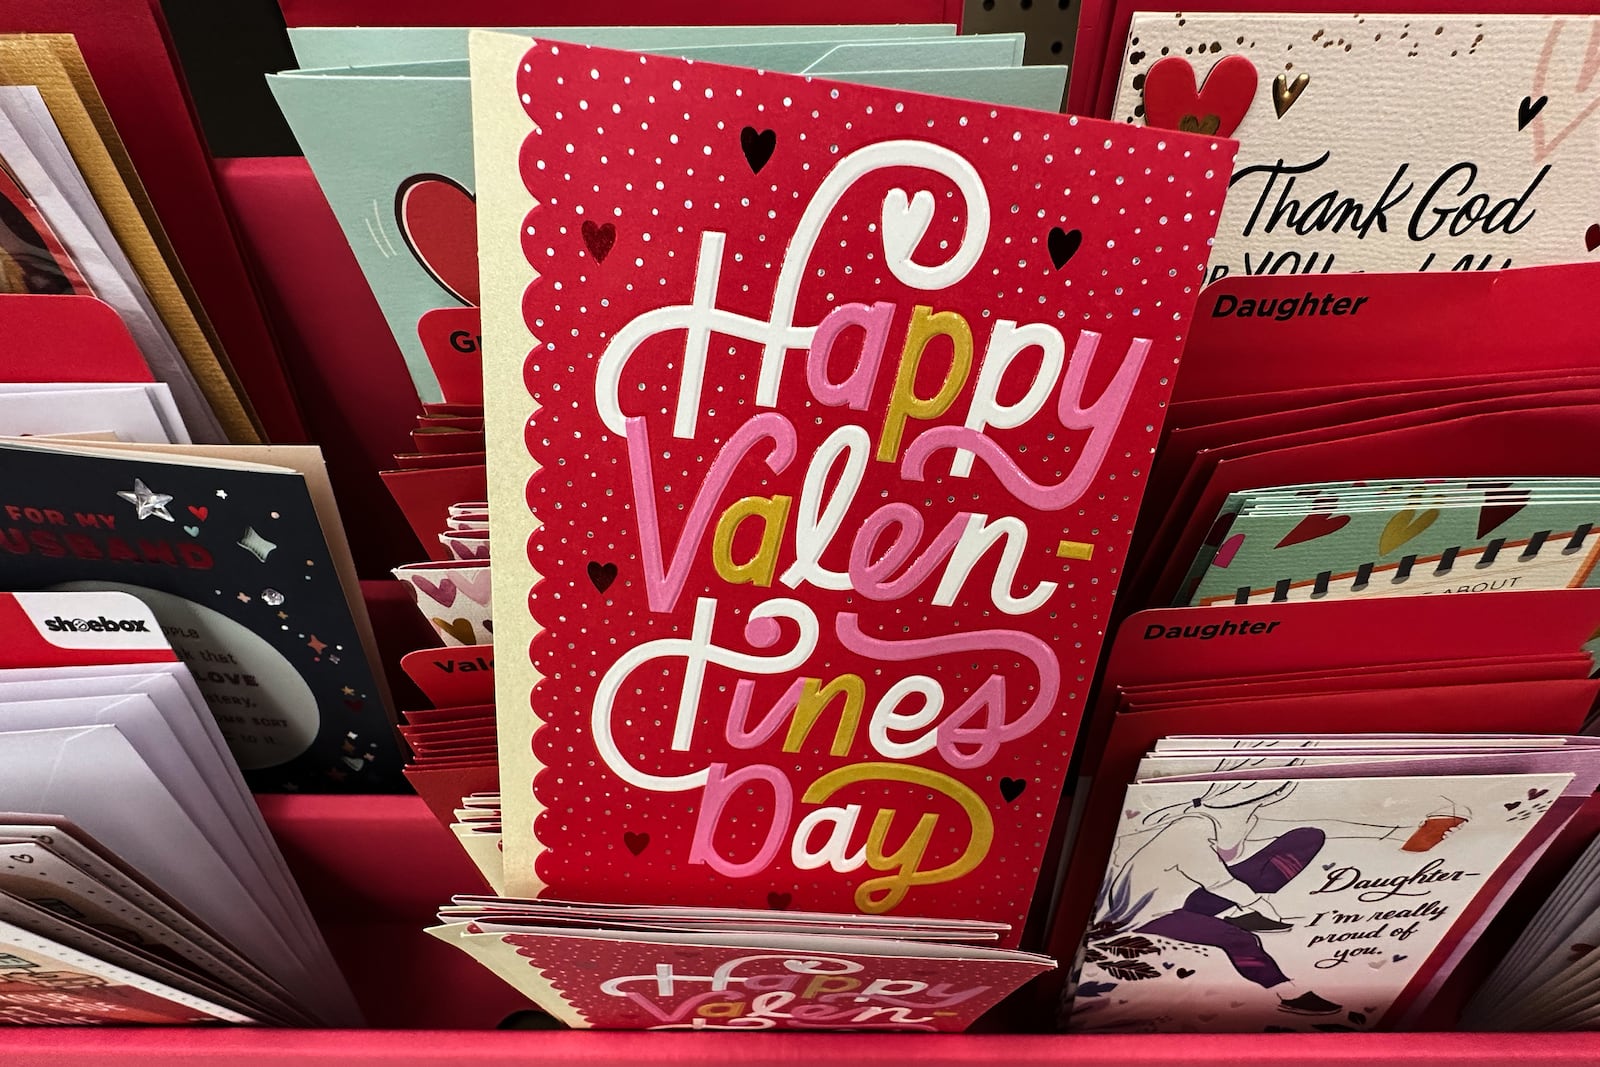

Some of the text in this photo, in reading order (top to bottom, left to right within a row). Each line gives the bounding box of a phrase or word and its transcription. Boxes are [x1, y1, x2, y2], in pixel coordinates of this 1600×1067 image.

[1228, 150, 1552, 242] Thank God
[1211, 291, 1369, 321] Daughter
[595, 140, 1153, 511] Happy
[4, 504, 116, 530] FOR MY
[625, 411, 1095, 614] Valen-
[0, 527, 215, 571] USBAND
[44, 616, 151, 633] shoebox
[1143, 620, 1281, 640] Daughter
[432, 656, 494, 673] Val
[591, 597, 1060, 791] tines
[688, 762, 994, 914] Day
[1309, 858, 1481, 902] Daughter-
[1304, 900, 1449, 928] I'm really
[1307, 921, 1420, 947] proud of
[1314, 946, 1382, 969] you.
[600, 954, 992, 1008] Happy
